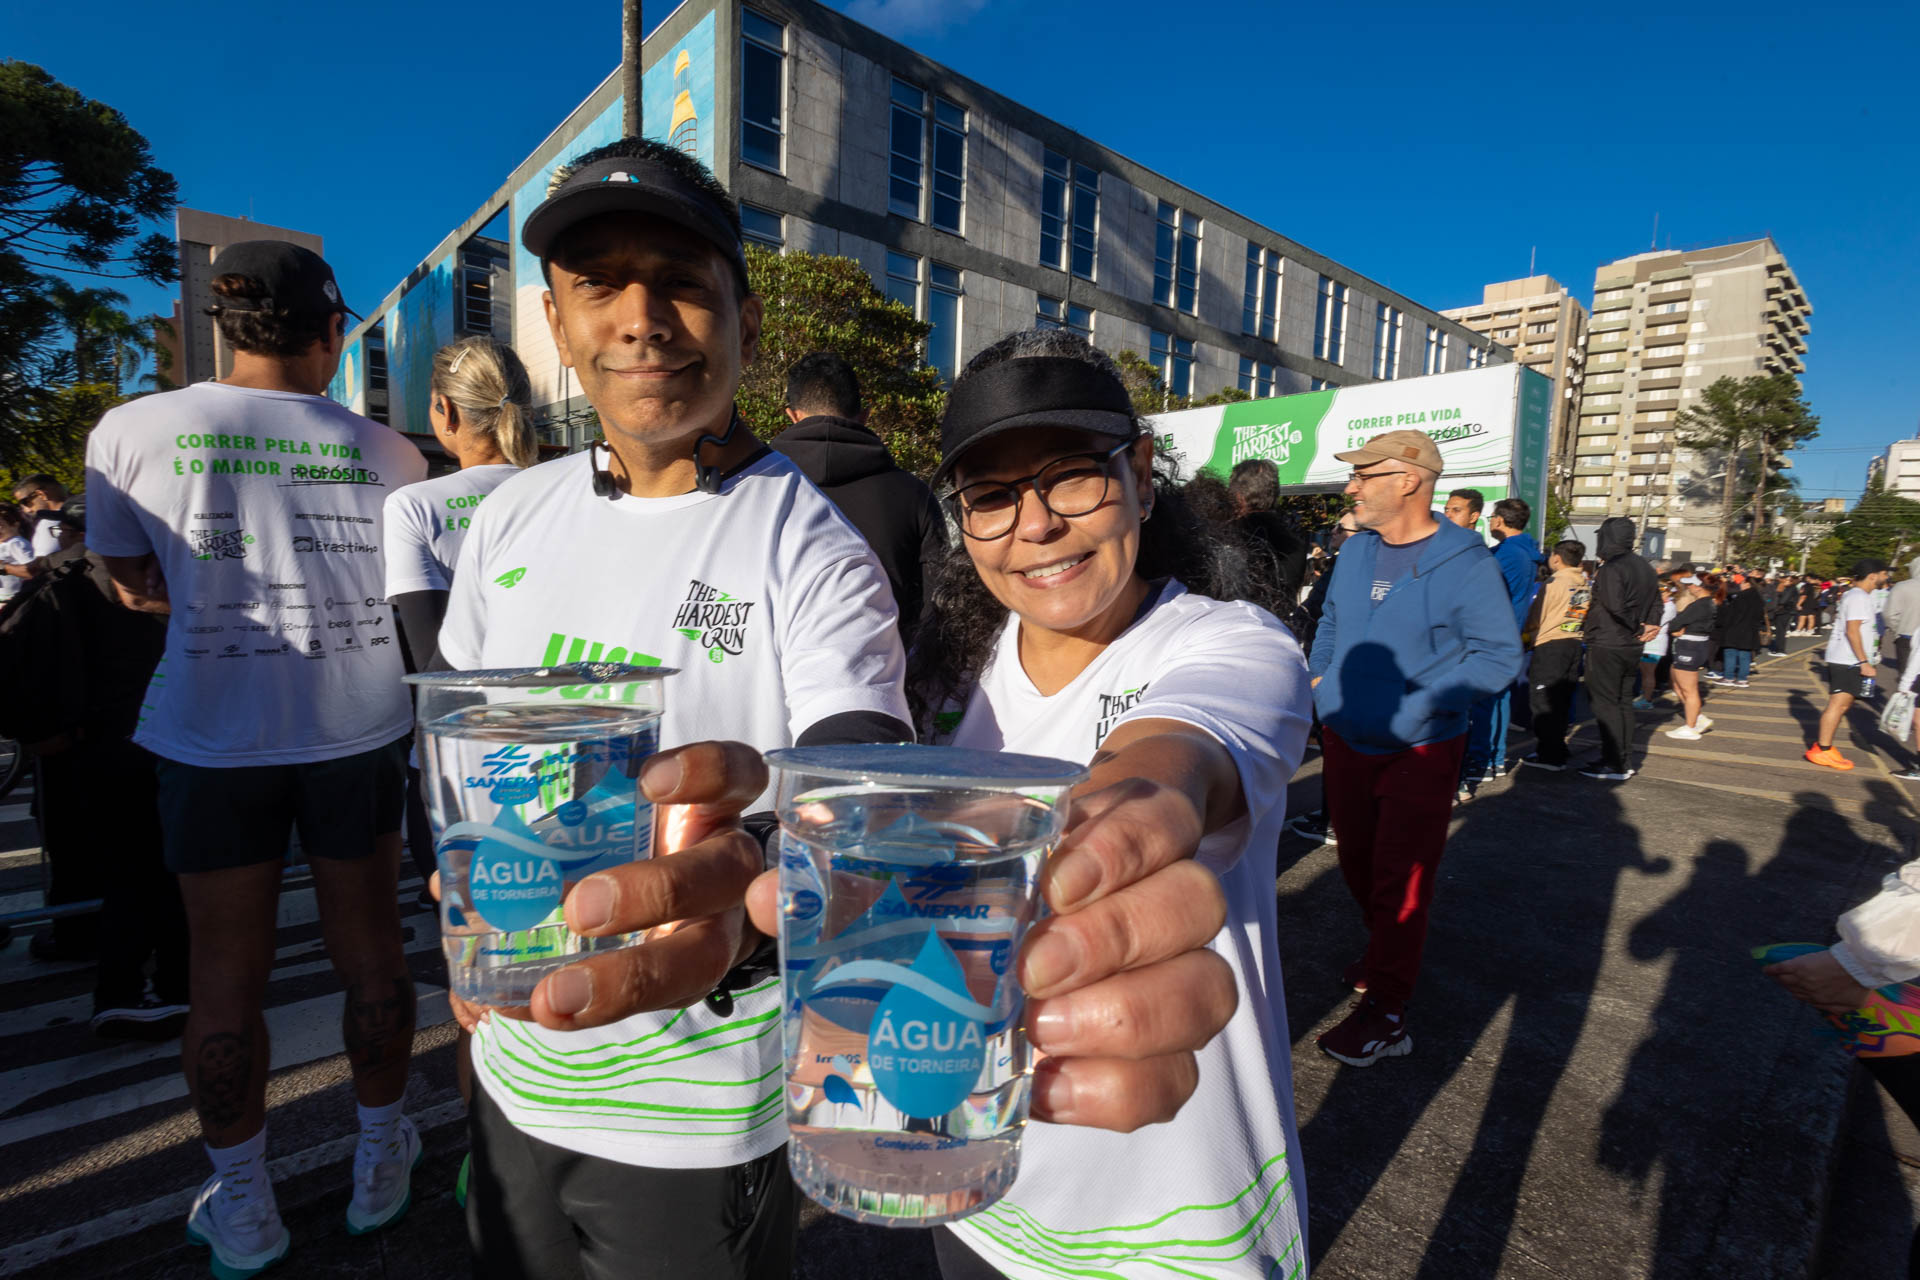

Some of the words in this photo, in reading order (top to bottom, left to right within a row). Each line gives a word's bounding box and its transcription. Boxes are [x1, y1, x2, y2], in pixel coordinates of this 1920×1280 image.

[1348, 416, 1392, 430] CORRER
[1397, 412, 1426, 425] PELA
[1431, 408, 1461, 421] VIDA
[1232, 421, 1292, 465] HARDEST
[1233, 425, 1257, 444] THE
[176, 434, 257, 450] CORRER
[265, 438, 312, 455] PELA
[319, 443, 362, 461] VIDA
[174, 457, 184, 475] É
[190, 459, 204, 474] O
[212, 459, 281, 476] MAIOR
[316, 541, 378, 554] Erastinho
[685, 579, 717, 601] THE
[672, 602, 755, 629] HARDEST
[702, 627, 748, 655] RUN
[472, 856, 560, 885] ÁGUA
[472, 888, 488, 900] DE
[491, 886, 560, 900] TORNEIRA
[876, 900, 990, 919] SANEPAR
[873, 1010, 983, 1051] ÁGUA
[871, 1054, 893, 1071] DE
[898, 1057, 980, 1074] TORNEIRA
